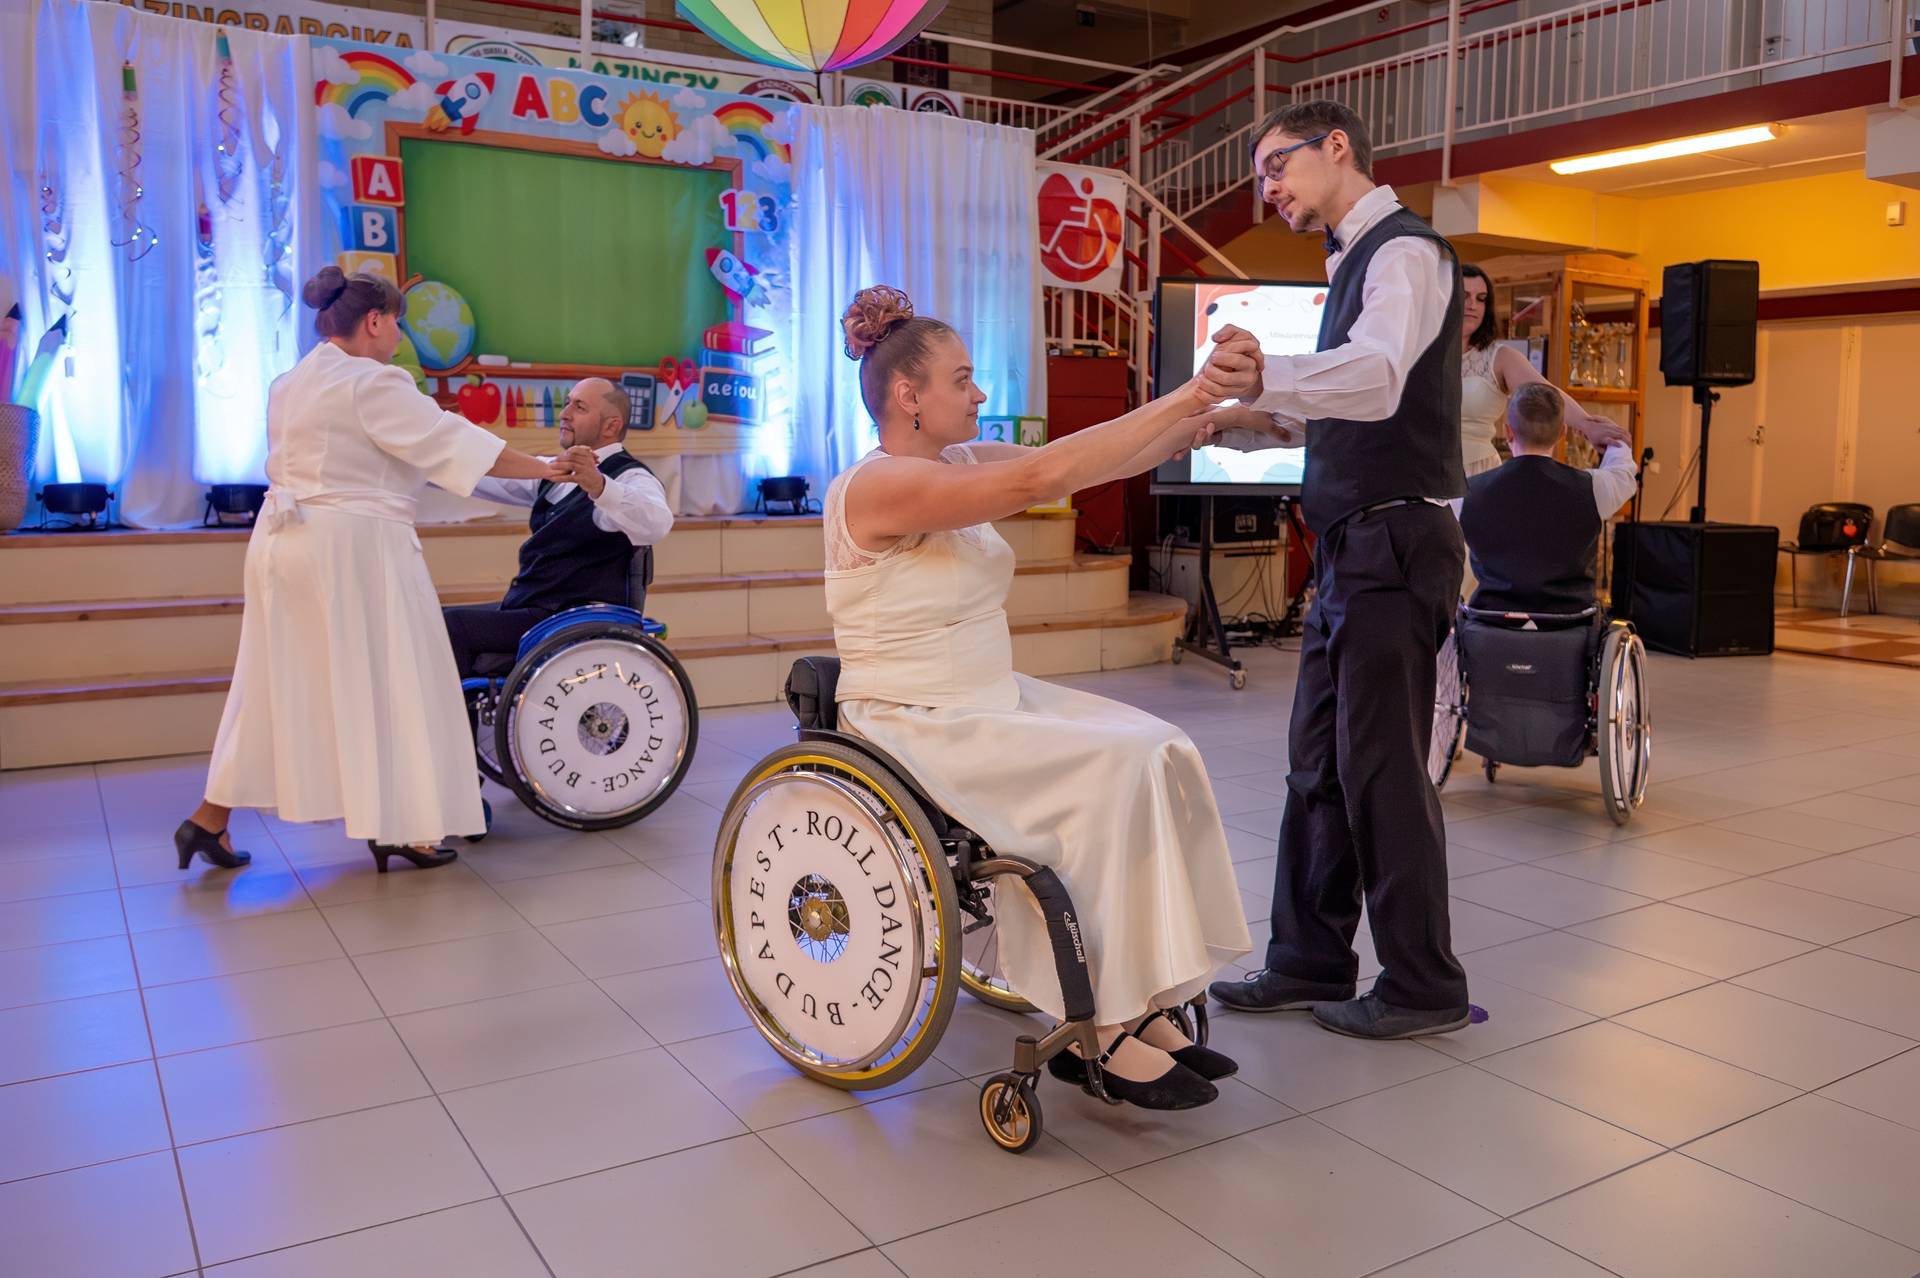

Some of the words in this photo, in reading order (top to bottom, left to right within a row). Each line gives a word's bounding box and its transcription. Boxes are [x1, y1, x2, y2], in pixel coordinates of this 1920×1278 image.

[512, 75, 609, 127] ABC
[367, 162, 396, 198] A
[362, 211, 388, 248] B
[721, 191, 778, 232] 123
